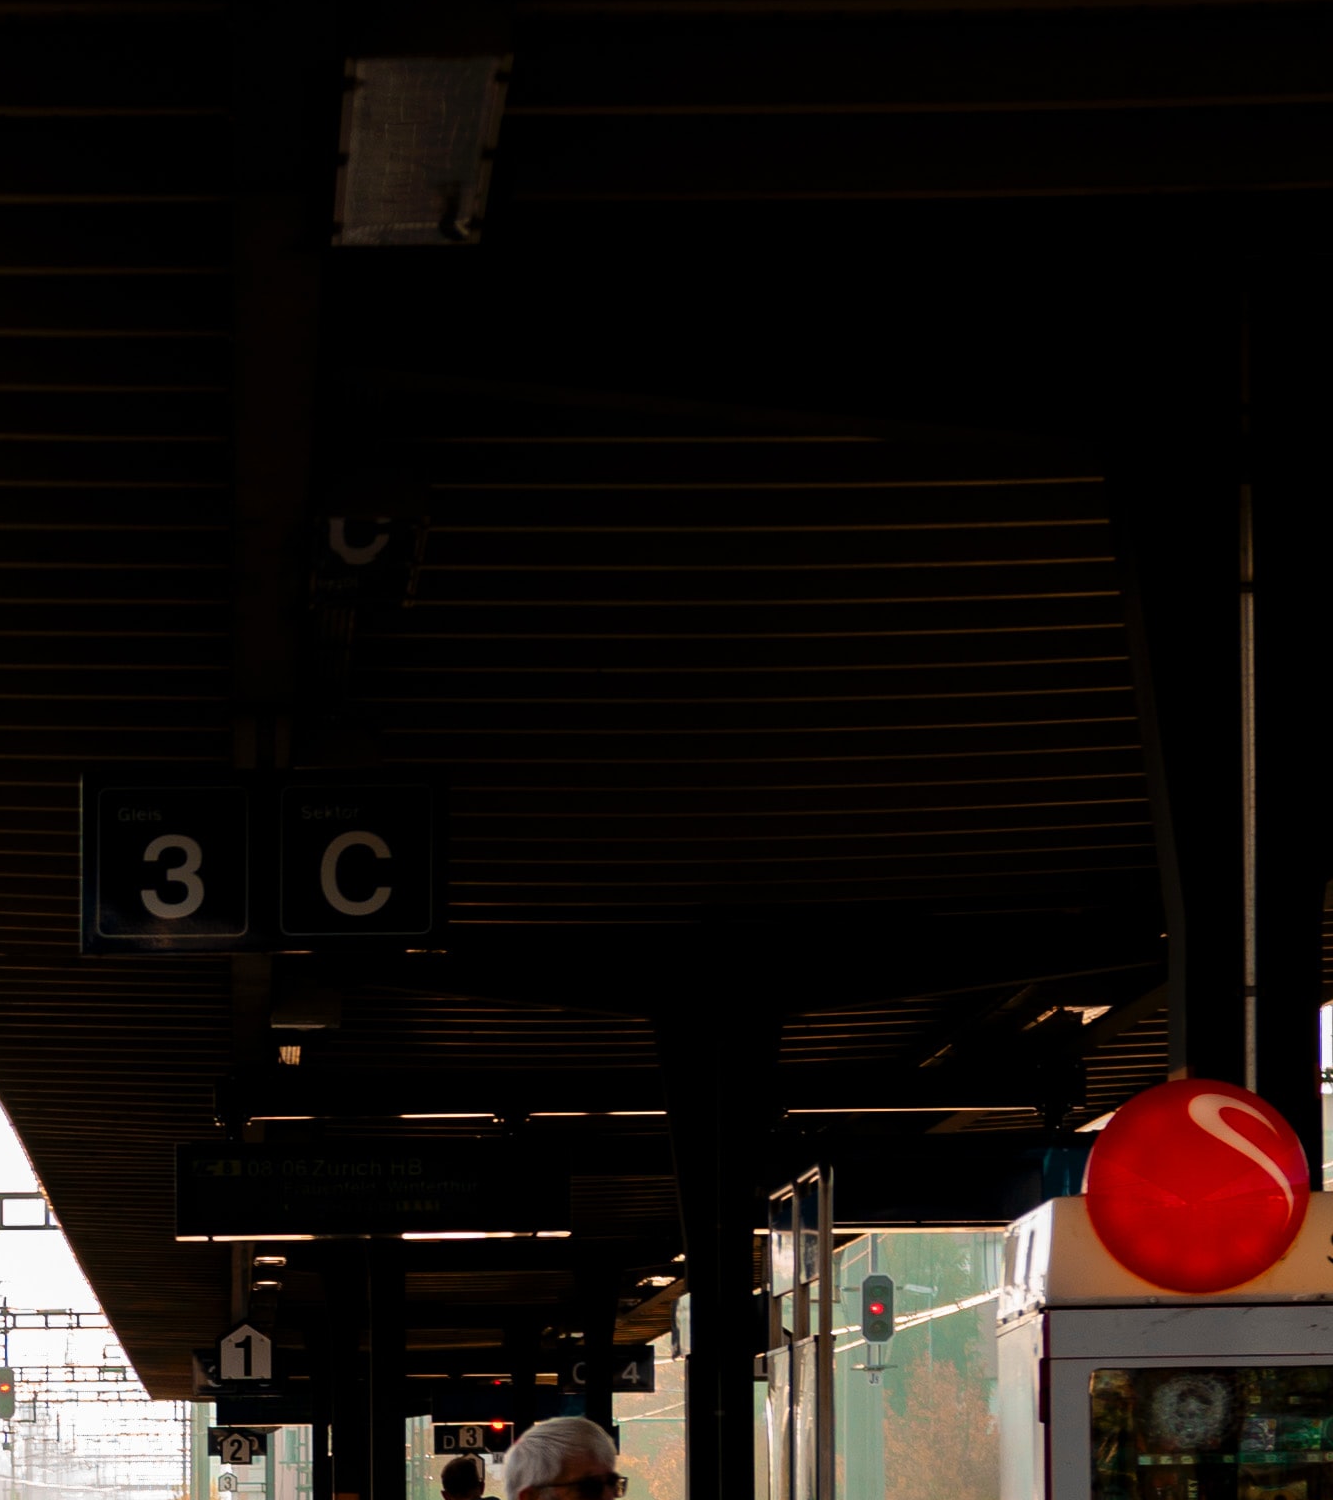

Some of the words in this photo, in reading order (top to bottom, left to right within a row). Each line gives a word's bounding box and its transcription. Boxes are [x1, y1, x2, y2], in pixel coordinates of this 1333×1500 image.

[117, 805, 163, 821] Gleis
[300, 804, 361, 820] Sektor
[139, 832, 206, 920] 3
[319, 829, 394, 917] C
[235, 1335, 252, 1377] 1
[621, 1361, 641, 1385] 4
[443, 1435, 456, 1450] D
[465, 1426, 477, 1447] 3
[229, 1438, 243, 1461] 2
[223, 1475, 233, 1491] 3
